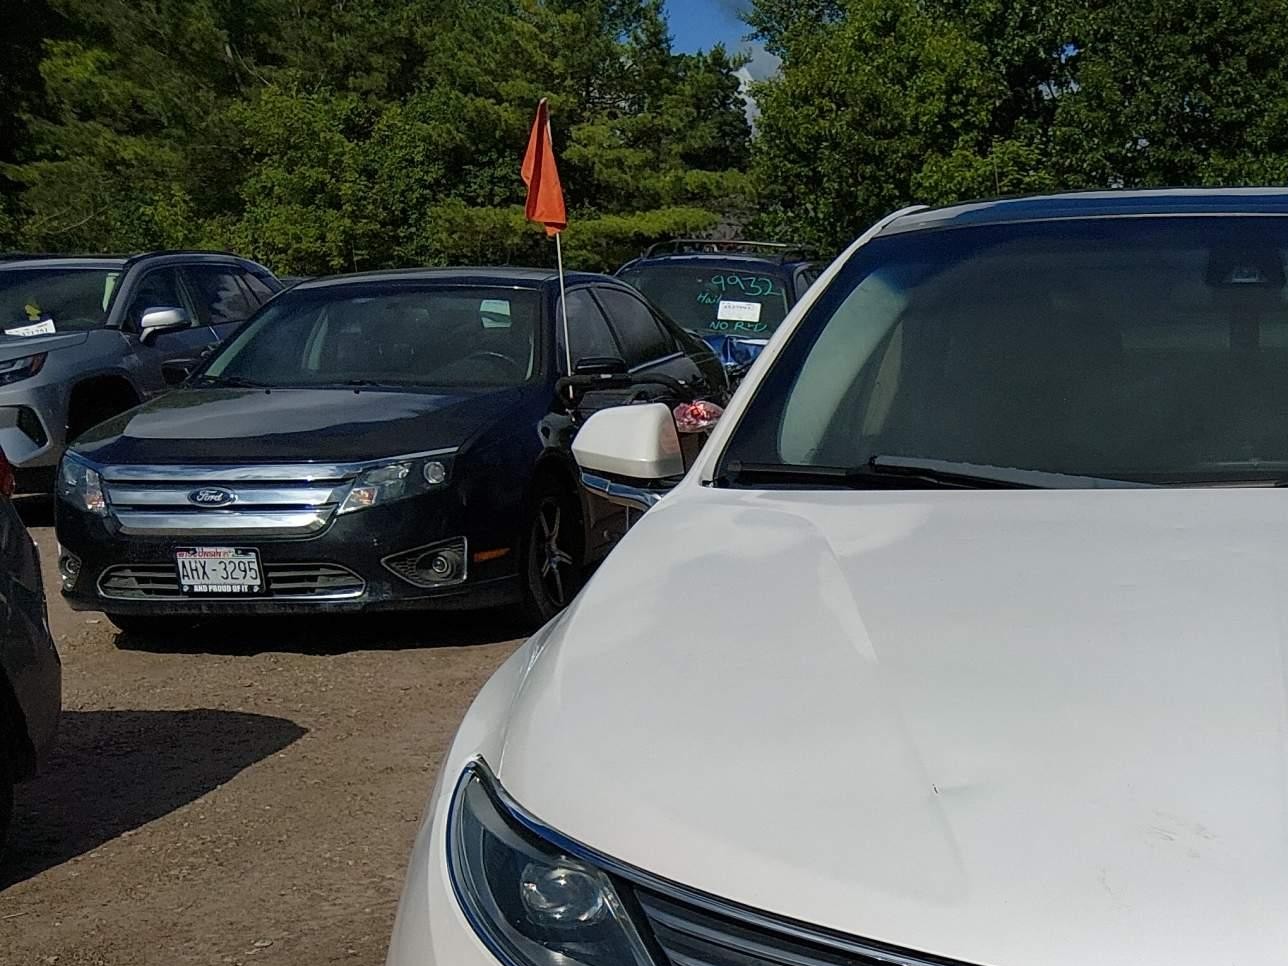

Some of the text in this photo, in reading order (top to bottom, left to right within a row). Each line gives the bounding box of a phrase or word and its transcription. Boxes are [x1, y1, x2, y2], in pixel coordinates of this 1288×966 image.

[711, 274, 782, 296] 9932
[710, 321, 729, 330] NO
[196, 490, 224, 502] Ford
[181, 560, 259, 580] AHX-3295
